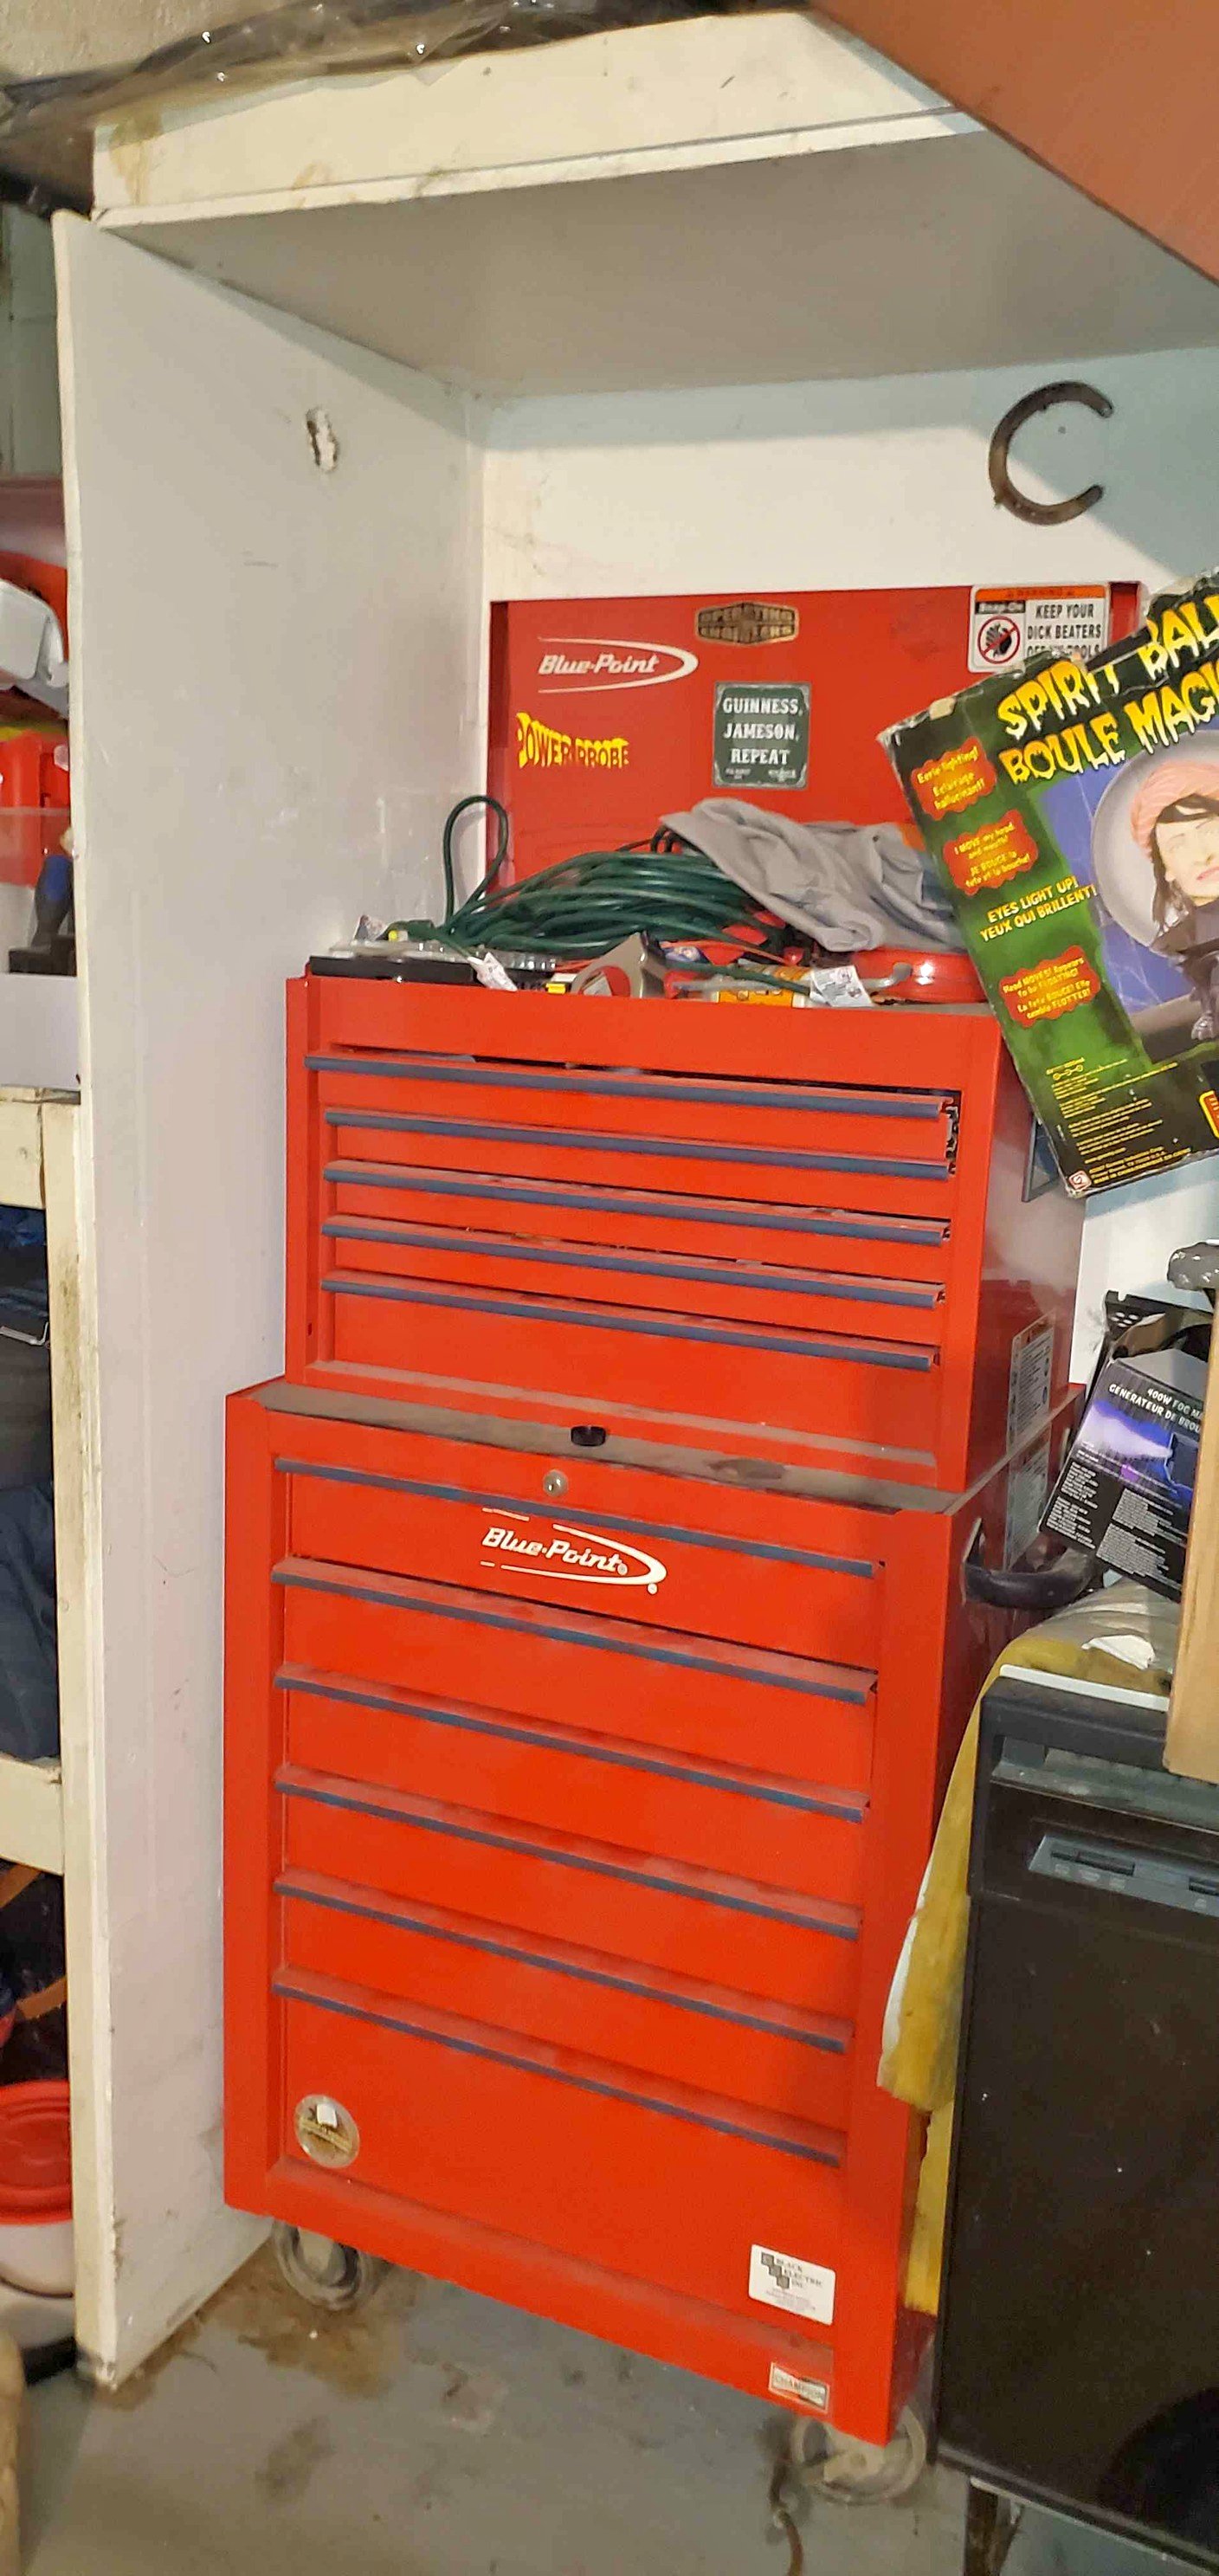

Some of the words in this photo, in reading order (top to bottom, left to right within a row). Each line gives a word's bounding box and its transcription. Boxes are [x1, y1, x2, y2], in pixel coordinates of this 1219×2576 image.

[1035, 604, 1063, 618] KEEP
[1066, 604, 1094, 618] YOUR
[1027, 624, 1052, 639] DICK
[1055, 623, 1101, 639] BEATERS
[538, 653, 660, 675] Blue-Point
[722, 697, 803, 717] GUINNESS,
[722, 723, 800, 742] JAMESON,
[998, 712, 1125, 784] BOULE
[1124, 660, 1219, 755] MAGI
[515, 712, 571, 768] POWER
[575, 738, 629, 769] PROBE
[730, 748, 790, 765] REPEAT
[987, 901, 1019, 923] EYES
[1020, 885, 1053, 909] LIGHT
[1056, 875, 1079, 894] UP!
[980, 920, 1013, 941] YEUX
[1014, 909, 1036, 928] QUI
[1036, 884, 1097, 919] BRILLENT!
[1147, 1388, 1172, 1405] 400W
[1172, 1399, 1191, 1414] FOG
[1164, 1410, 1177, 1421] DE
[481, 1527, 623, 1573] Blue-Point
